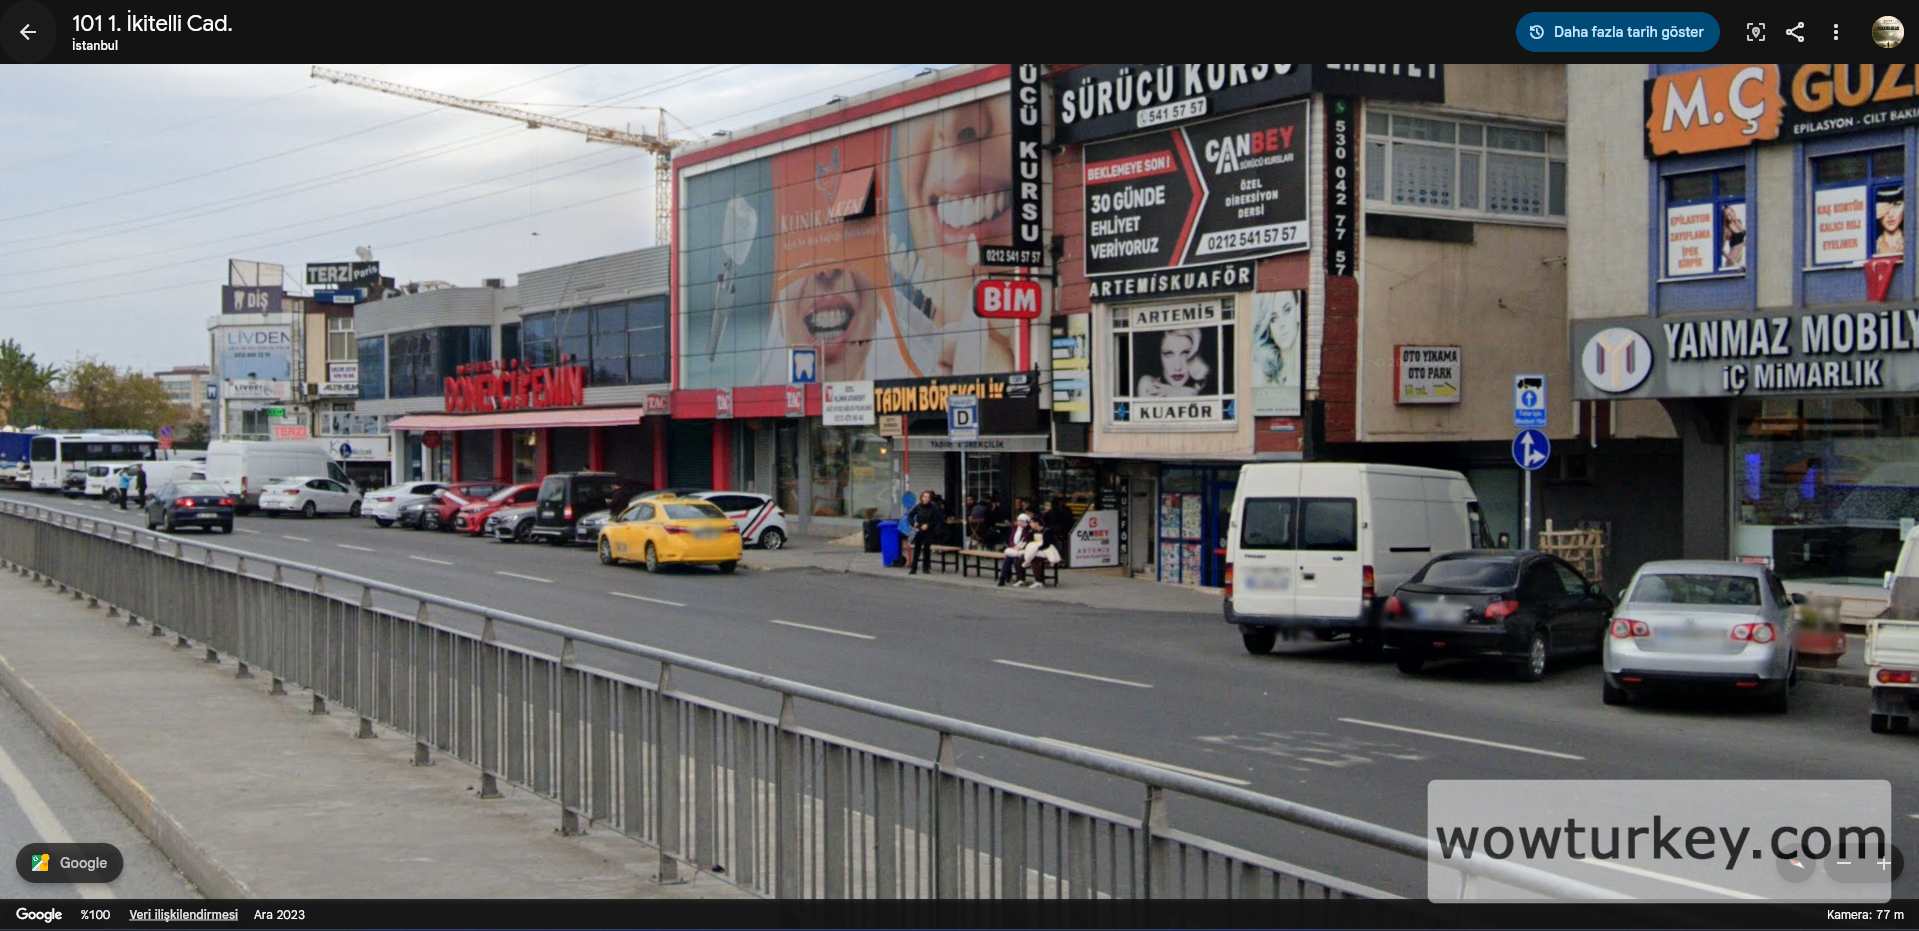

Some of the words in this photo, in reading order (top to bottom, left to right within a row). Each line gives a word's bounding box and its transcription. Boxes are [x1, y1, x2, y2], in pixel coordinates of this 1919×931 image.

[1185, 64, 1294, 96] KUR
[1149, 108, 1168, 123] 541
[1173, 104, 1186, 118] 57
[1191, 101, 1204, 115] 57
[1793, 117, 1853, 135] EPİLASYON
[1863, 112, 1887, 125] CİLT
[1890, 107, 1919, 120] BAKI
[1205, 125, 1295, 175] CANBEY
[1335, 120, 1346, 159] 530
[1088, 161, 1143, 181] BEKLEMEYE
[1239, 158, 1263, 170] SÜRÜCÜ
[1264, 153, 1294, 166] KURSLARI
[1020, 141, 1038, 242] KURSU
[1240, 179, 1262, 191] ÖZEL
[1335, 166, 1346, 205] 042
[1091, 193, 1111, 214] 30
[1113, 185, 1165, 211] GÜNDE
[1225, 190, 1279, 207] DİREKSİYON
[1238, 204, 1264, 219] DERSİ
[1091, 215, 1141, 236] EHLİYET
[1335, 215, 1346, 240] 77
[1091, 237, 1159, 259] VERİYORUZ
[1208, 234, 1236, 250] 0212
[1240, 231, 1260, 246] 541
[1264, 228, 1278, 243] 57
[1282, 226, 1297, 241] 57
[986, 250, 1005, 263] 0212
[1006, 250, 1019, 263] 541
[1021, 250, 1030, 262] 57
[1032, 250, 1041, 262] 57
[1335, 251, 1346, 276] 57
[308, 262, 352, 282] TERZİ
[354, 264, 378, 280] Paris
[247, 289, 268, 311] DİŞ
[984, 281, 1037, 312] BİM
[1136, 303, 1214, 324] ARTEMİS
[1663, 317, 1789, 359] YANMAZ
[1403, 350, 1420, 362] OTO
[1423, 350, 1458, 362] YIKAMA
[1409, 368, 1425, 379] OTO
[1427, 367, 1452, 379] PARK
[649, 397, 667, 410] TAÇ
[718, 395, 730, 410] TAÇ
[787, 392, 801, 407] TAÇ
[875, 386, 917, 414] TADIM
[957, 410, 969, 425] D
[1140, 403, 1212, 419] KUAFÖR
